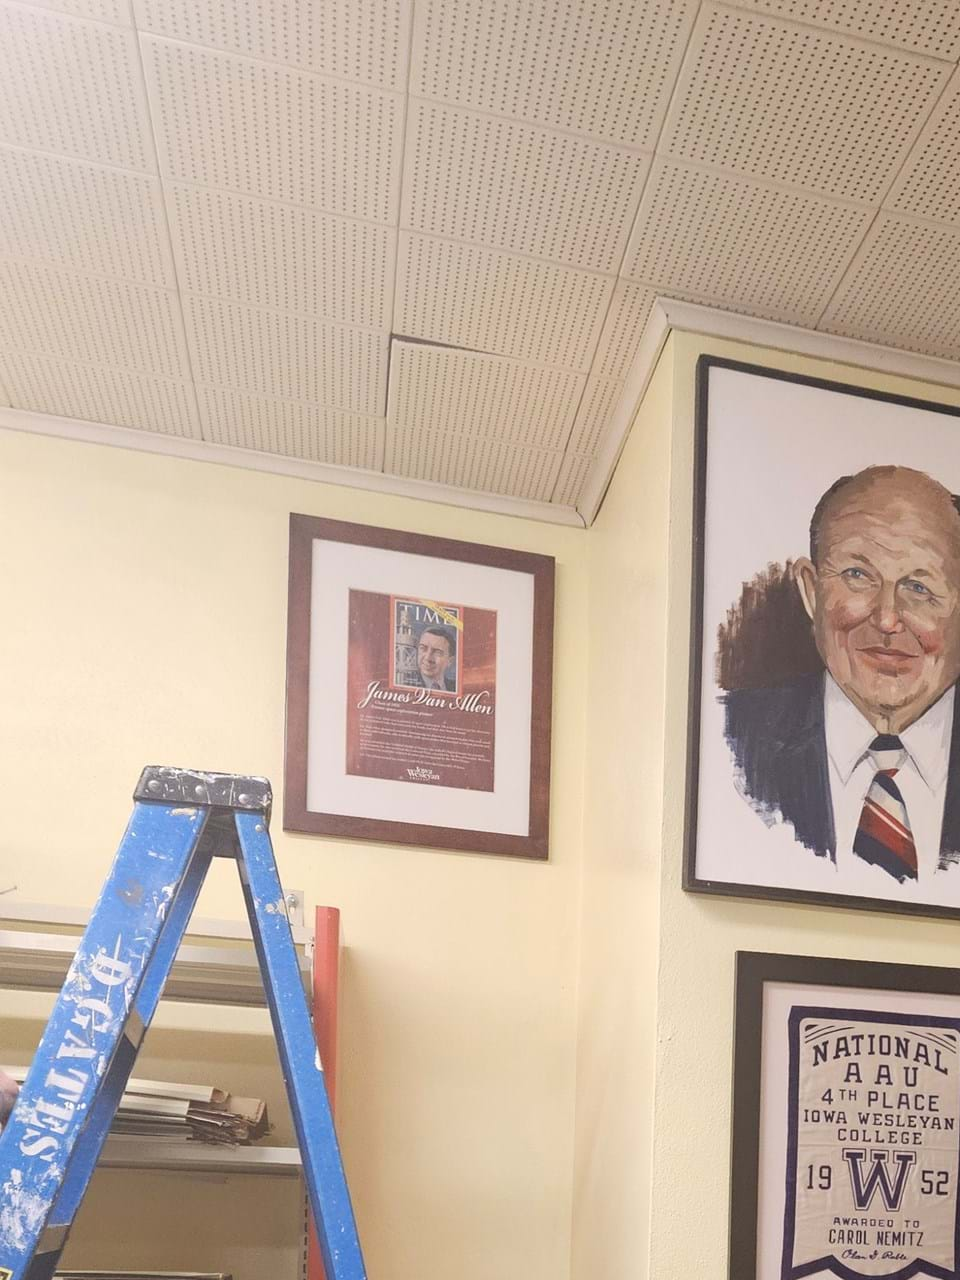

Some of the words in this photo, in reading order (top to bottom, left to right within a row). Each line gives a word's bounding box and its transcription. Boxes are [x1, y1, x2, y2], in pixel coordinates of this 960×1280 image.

[358, 681, 410, 708] James
[413, 688, 448, 708] Van
[450, 691, 493, 715] Allen
[812, 1034, 948, 1076] NATIONAL
[19, 998, 114, 1161] GATES
[821, 1090, 858, 1106] 4TH
[867, 1091, 940, 1112] PLACE
[803, 1109, 848, 1124] IOWA
[858, 1111, 955, 1130] WESLEYAN
[837, 1128, 923, 1145] COLLEGE
[842, 1148, 916, 1212] W
[833, 1217, 894, 1228] AWARDED
[904, 1219, 920, 1229] TO
[829, 1229, 869, 1245] CAROL
[877, 1232, 924, 1246] NEMITZ
